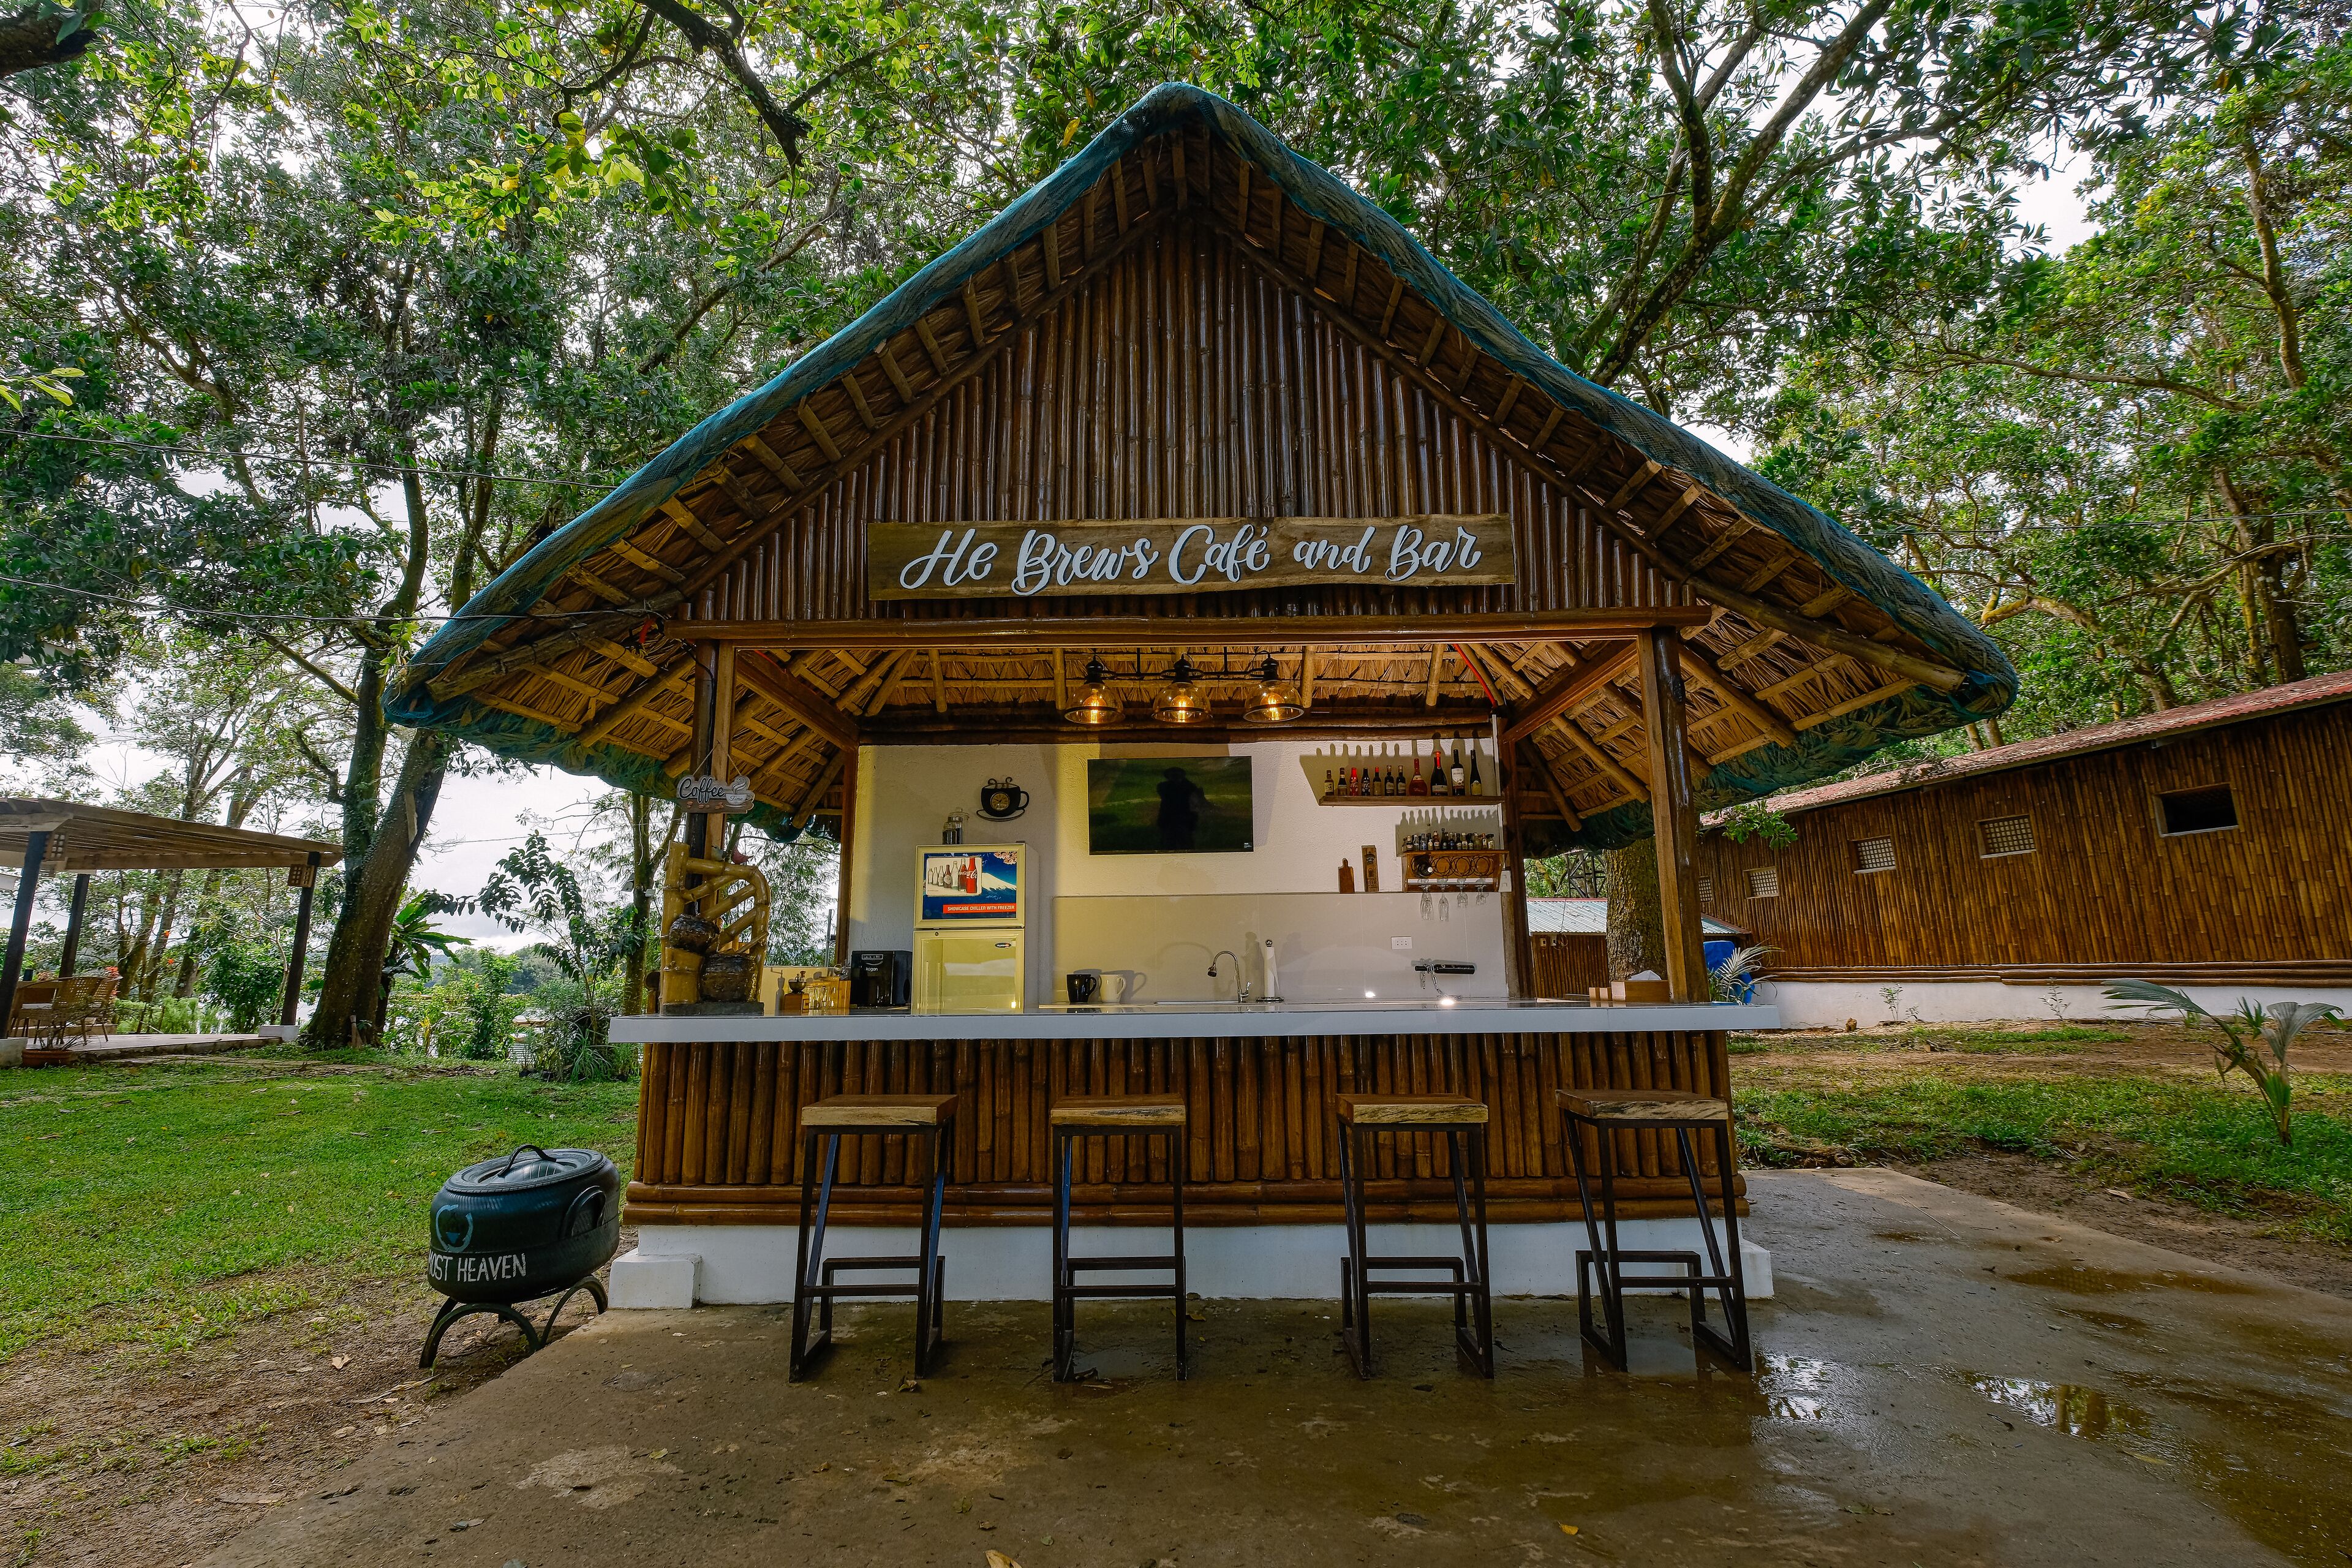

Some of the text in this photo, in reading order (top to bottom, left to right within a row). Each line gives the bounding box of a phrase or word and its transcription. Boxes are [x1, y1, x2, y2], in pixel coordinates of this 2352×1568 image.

[900, 524, 1482, 595] He Brews Café and Bar
[679, 777, 725, 803] Coffee
[458, 1253, 526, 1282] HEAVEN
